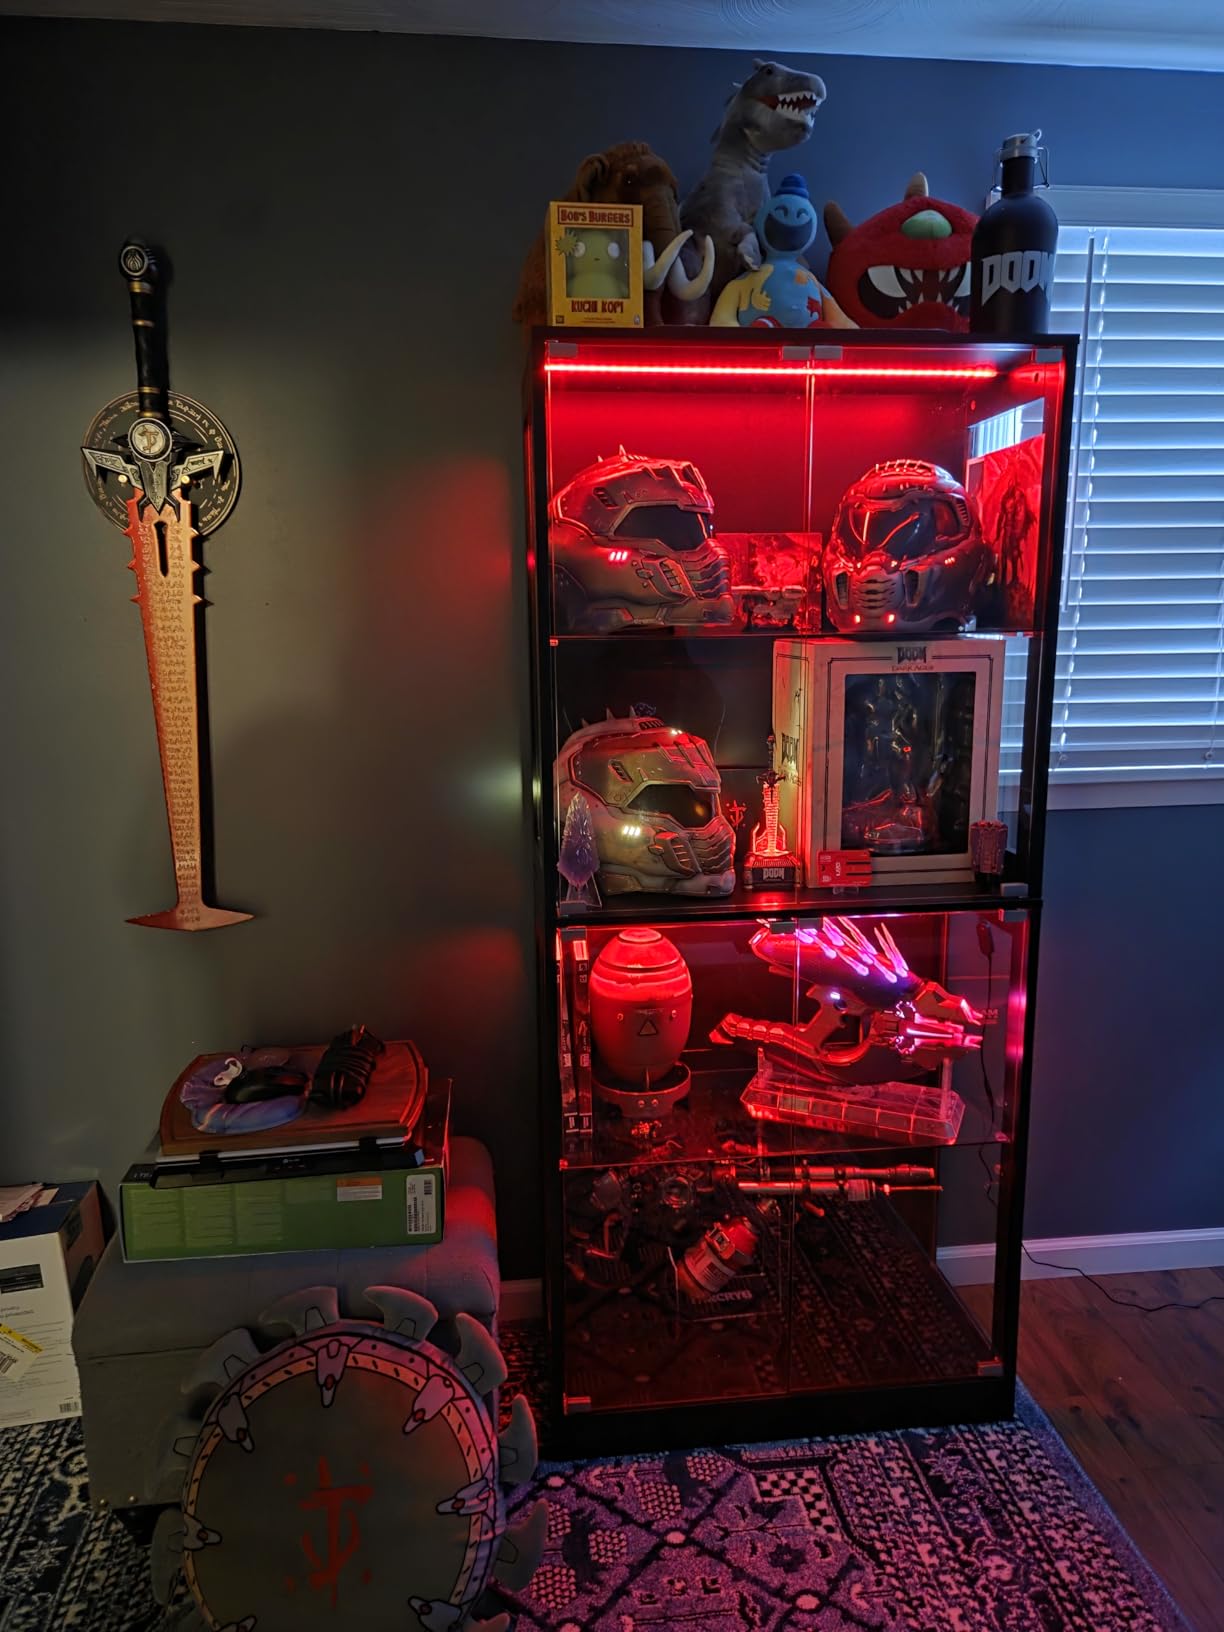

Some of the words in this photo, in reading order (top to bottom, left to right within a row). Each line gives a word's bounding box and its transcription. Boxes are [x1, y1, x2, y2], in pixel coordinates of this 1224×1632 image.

[560, 209, 587, 222] BOB'S
[588, 209, 631, 224] BURGERS
[981, 250, 1053, 307] DOOM
[571, 300, 598, 313] KUCHI
[601, 300, 624, 313] KOPI
[897, 646, 927, 664] DOOM
[762, 867, 785, 881] DOOM
